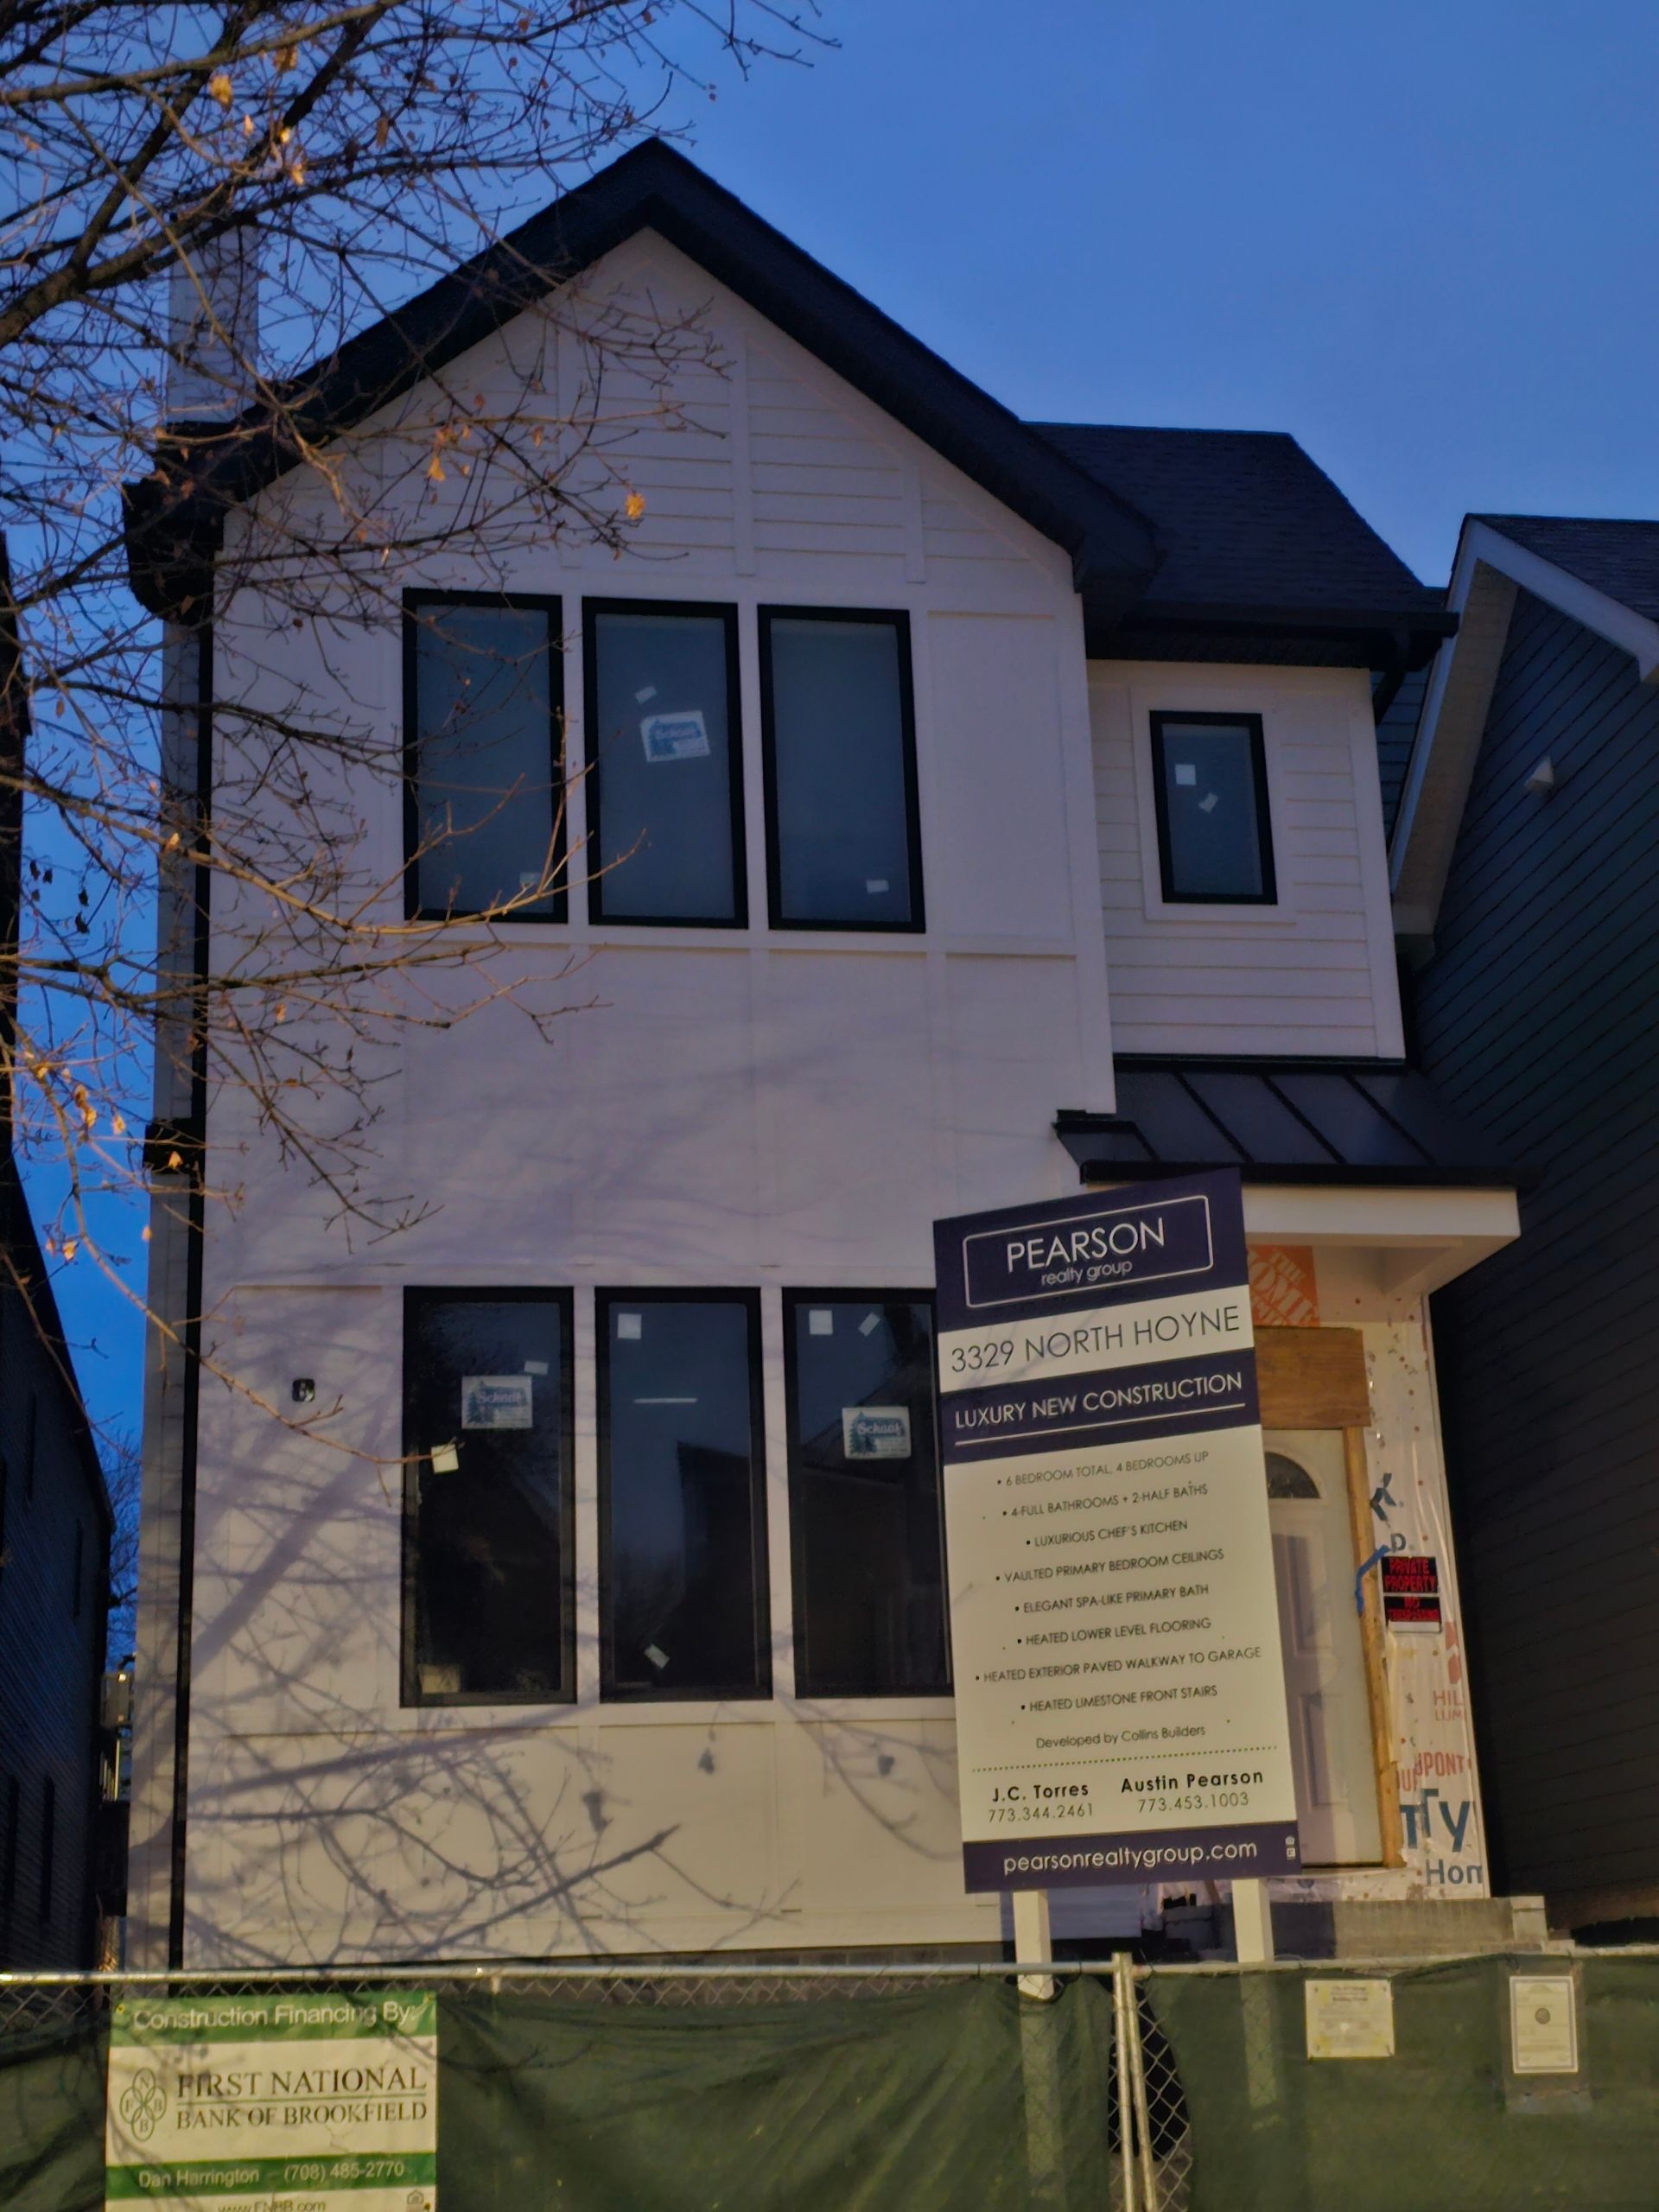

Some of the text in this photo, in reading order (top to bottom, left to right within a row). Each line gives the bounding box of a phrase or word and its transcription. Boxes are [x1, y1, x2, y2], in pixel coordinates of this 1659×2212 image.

[1007, 1217, 1165, 1273] PEARSON
[1041, 1260, 1133, 1286] realty group
[950, 1340, 1014, 1373] 3329
[1026, 1324, 1122, 1362] NORTH
[1135, 1306, 1240, 1345] HOYNE
[955, 1372, 1242, 1429] LUXURY NEW CONSTRUCTION
[1006, 1474, 1013, 1486] 6
[1014, 1467, 1073, 1485] BEDROOM
[1116, 1459, 1123, 1472] 4
[1125, 1453, 1191, 1471] BEDROOMS
[1193, 1451, 1210, 1464] UP
[1011, 1503, 1045, 1517] 4-FULL
[1047, 1495, 1119, 1514] BATHROOMS
[1132, 1489, 1170, 1504] 2-HALF
[1173, 1484, 1209, 1499] BATHS
[1034, 1520, 1188, 1548] LUXURIOUS CHEF'S KITCHEN
[1004, 1549, 1224, 1583] VAULTED PRIMARY BEDROOM CEILINGS
[1023, 1583, 1210, 1614] ELEGANT SPA-LIKE PRIMARY BATH
[1026, 1617, 1211, 1646] HEATED LOWER LEVEL FLOORING
[983, 1646, 1262, 1683] HEATED EXTERIOR PAVED WALKWAY TO GARAGE
[1029, 1684, 1217, 1713] HEATED LIMESTONE FRONT STAIRS
[1036, 1724, 1206, 1751] Developed by Collins Builders
[992, 1782, 1090, 1803] J.C. Torres
[1121, 1769, 1264, 1794] Austin Pearson
[988, 1803, 1094, 1823] 773.344.2461
[1137, 1792, 1249, 1813] 773.453.1003
[1003, 1840, 1258, 1876] pearsonrealtygroup.com
[134, 2003, 268, 2031] Construction
[274, 2003, 378, 2027] Financing
[177, 2066, 427, 2098] FIRST NATIONAL
[176, 2101, 427, 2130] BANK OF BROOKFIELD
[138, 2167, 259, 2191] Dan Harrington
[283, 2160, 404, 2183] (708) 485-2770
[218, 2200, 327, 2212] wwwFNBB.com
